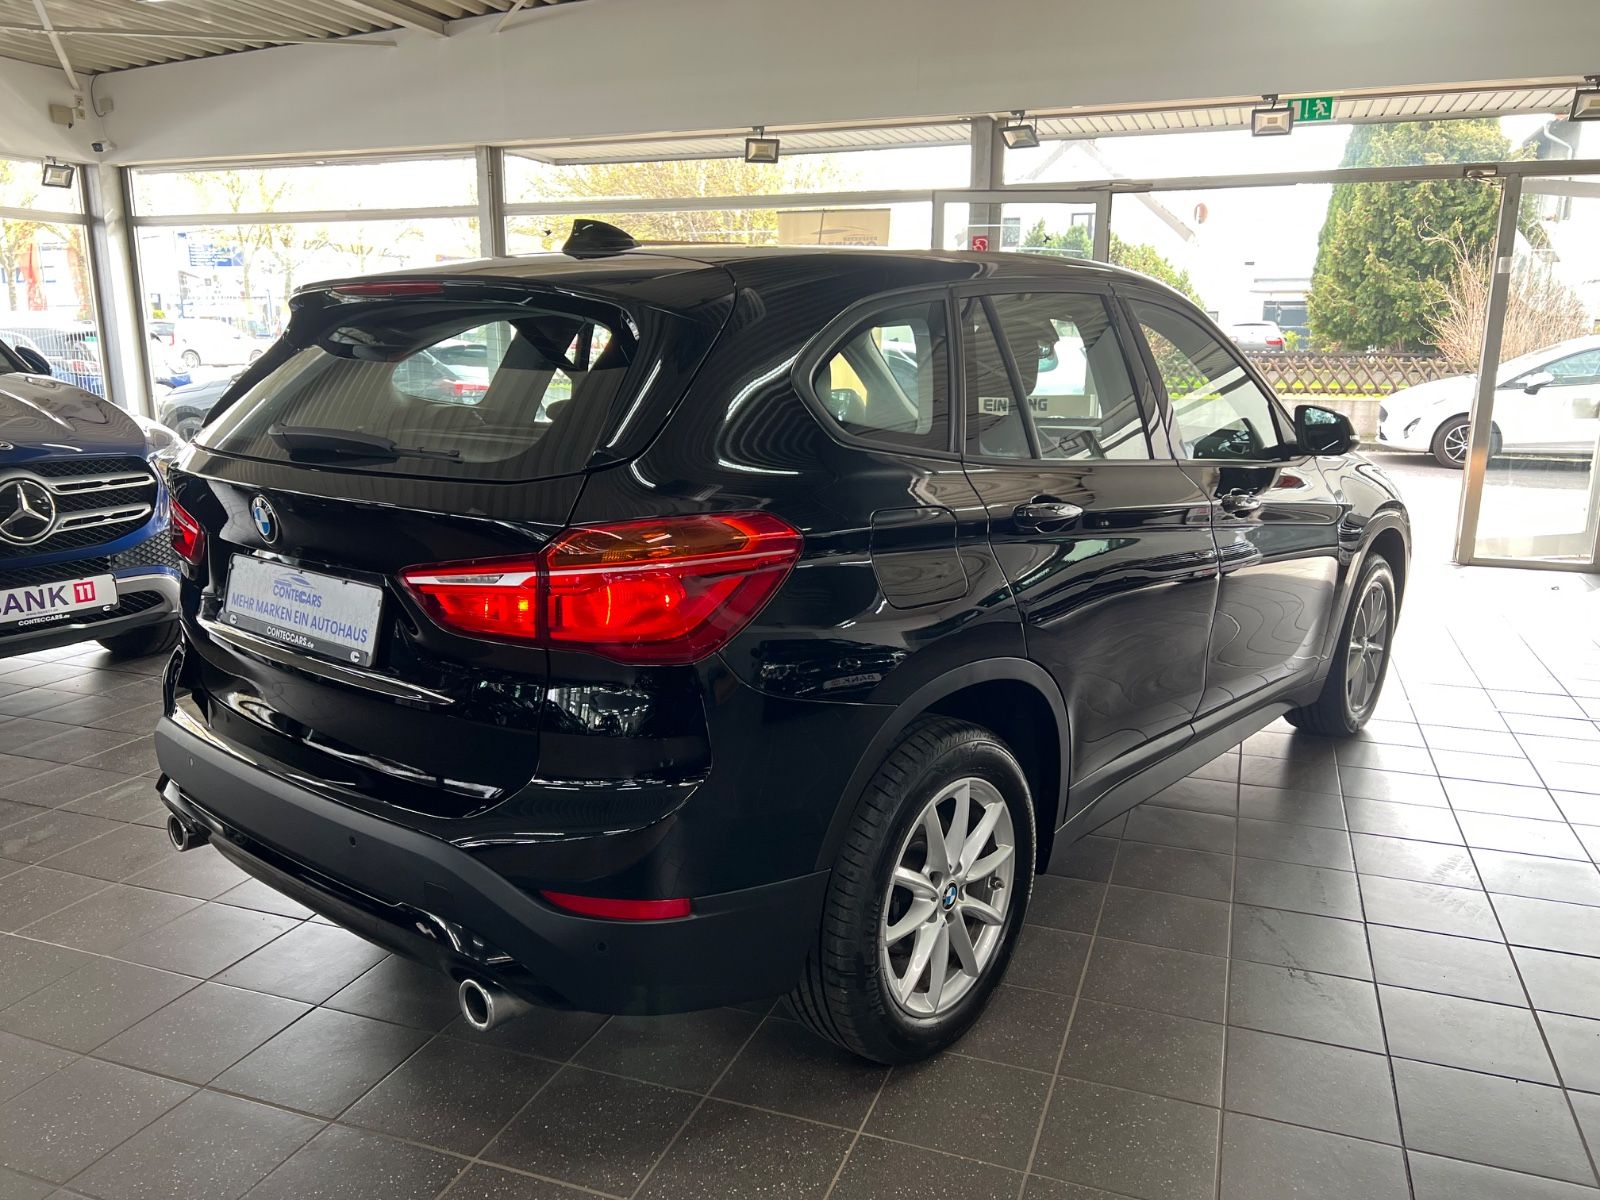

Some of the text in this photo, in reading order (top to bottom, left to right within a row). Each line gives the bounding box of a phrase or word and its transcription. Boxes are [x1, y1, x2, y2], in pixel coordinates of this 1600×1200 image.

[983, 398, 1049, 412] EINNG
[0, 583, 95, 615] ANK 11
[18, 613, 71, 626] CONTECCARS.de
[231, 592, 368, 644] MEHR MARKEN EIN AUTOHAUS
[266, 626, 315, 649] CONTECCARS.de
